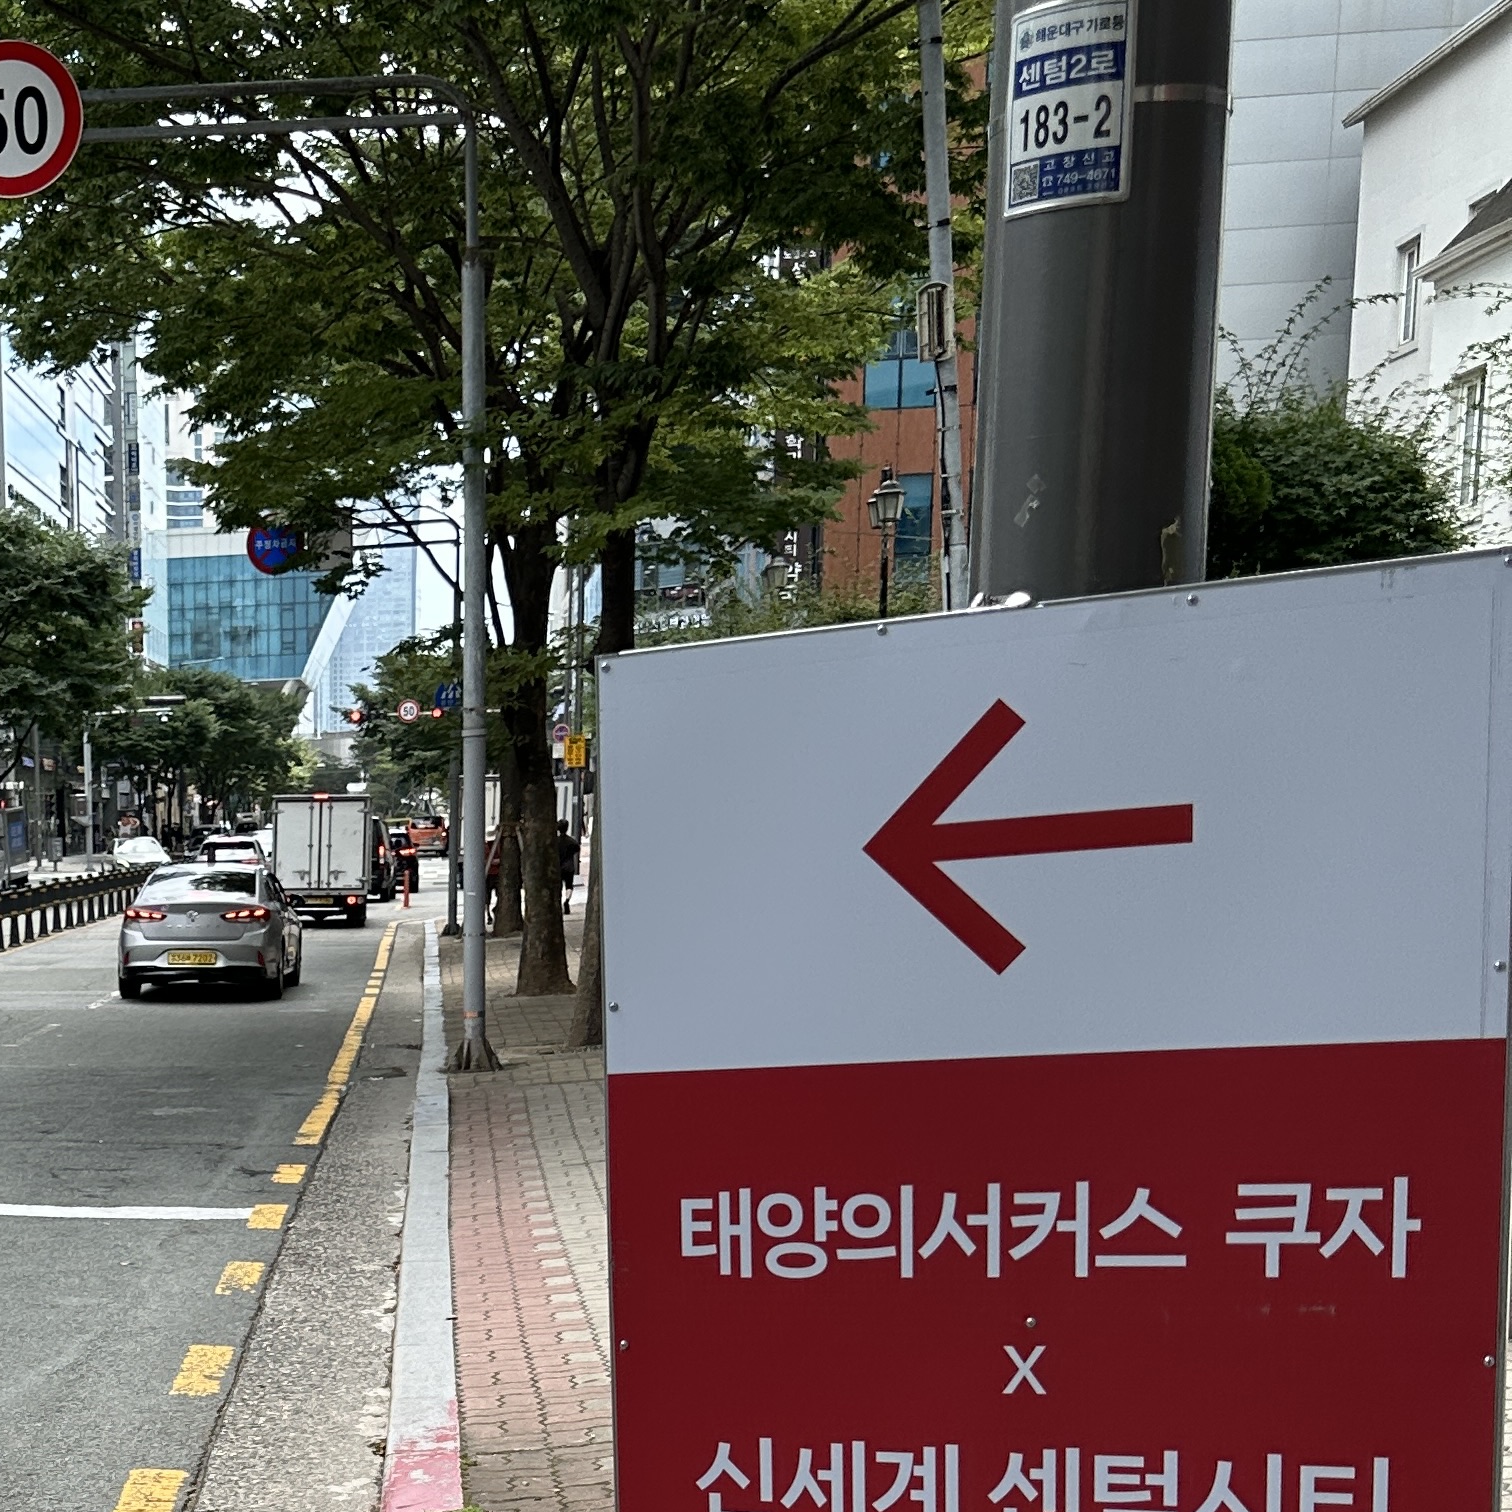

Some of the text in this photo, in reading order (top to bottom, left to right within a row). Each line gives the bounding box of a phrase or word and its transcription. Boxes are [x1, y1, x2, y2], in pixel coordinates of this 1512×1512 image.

[1036, 20, 1084, 42] 해운대구
[1019, 49, 1116, 91] 센텀2로
[1020, 95, 1111, 152] 183-2
[1057, 168, 1115, 186] 749-4671
[403, 706, 415, 717] 50
[680, 1175, 1422, 1280] 태양의서커스 쿠자
